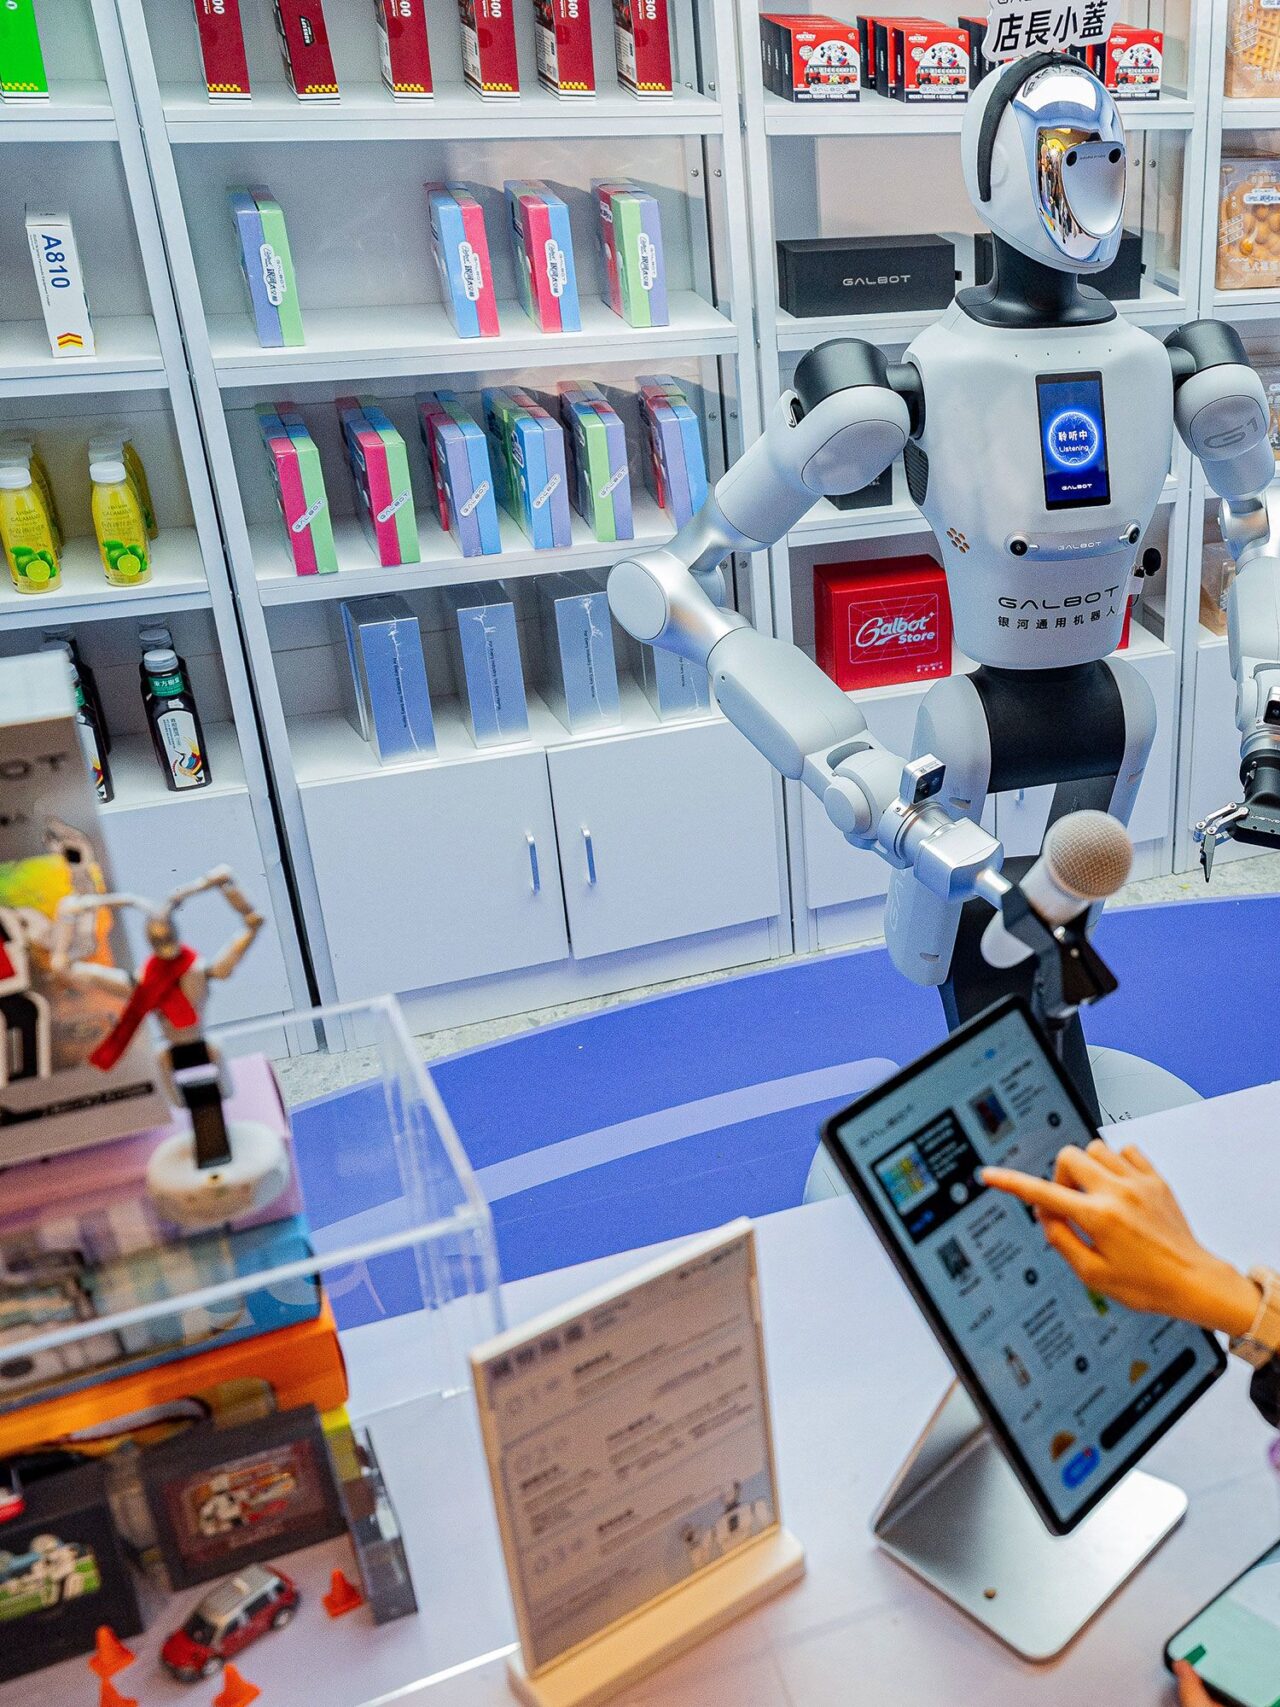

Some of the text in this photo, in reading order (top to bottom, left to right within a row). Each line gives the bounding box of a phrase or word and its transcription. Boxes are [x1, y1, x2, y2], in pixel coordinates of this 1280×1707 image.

[992, 2, 1108, 53] 店長小蓋
[42, 235, 70, 289] A810
[842, 274, 911, 286] GALBOT
[1058, 431, 1088, 442] 聆听中
[1203, 416, 1259, 448] G1
[1058, 444, 1089, 453] Listening
[535, 476, 560, 506] GALBOT
[600, 468, 628, 496] GALBOT
[379, 492, 409, 520] GALBOT
[464, 484, 488, 512] GALBOT
[295, 500, 322, 530] GALBOT
[1058, 541, 1102, 550] GALBOT
[998, 586, 1120, 610] GALBOT
[856, 616, 930, 648] Galbot
[998, 606, 1116, 630] 银河通用机器人
[898, 631, 936, 644] Store
